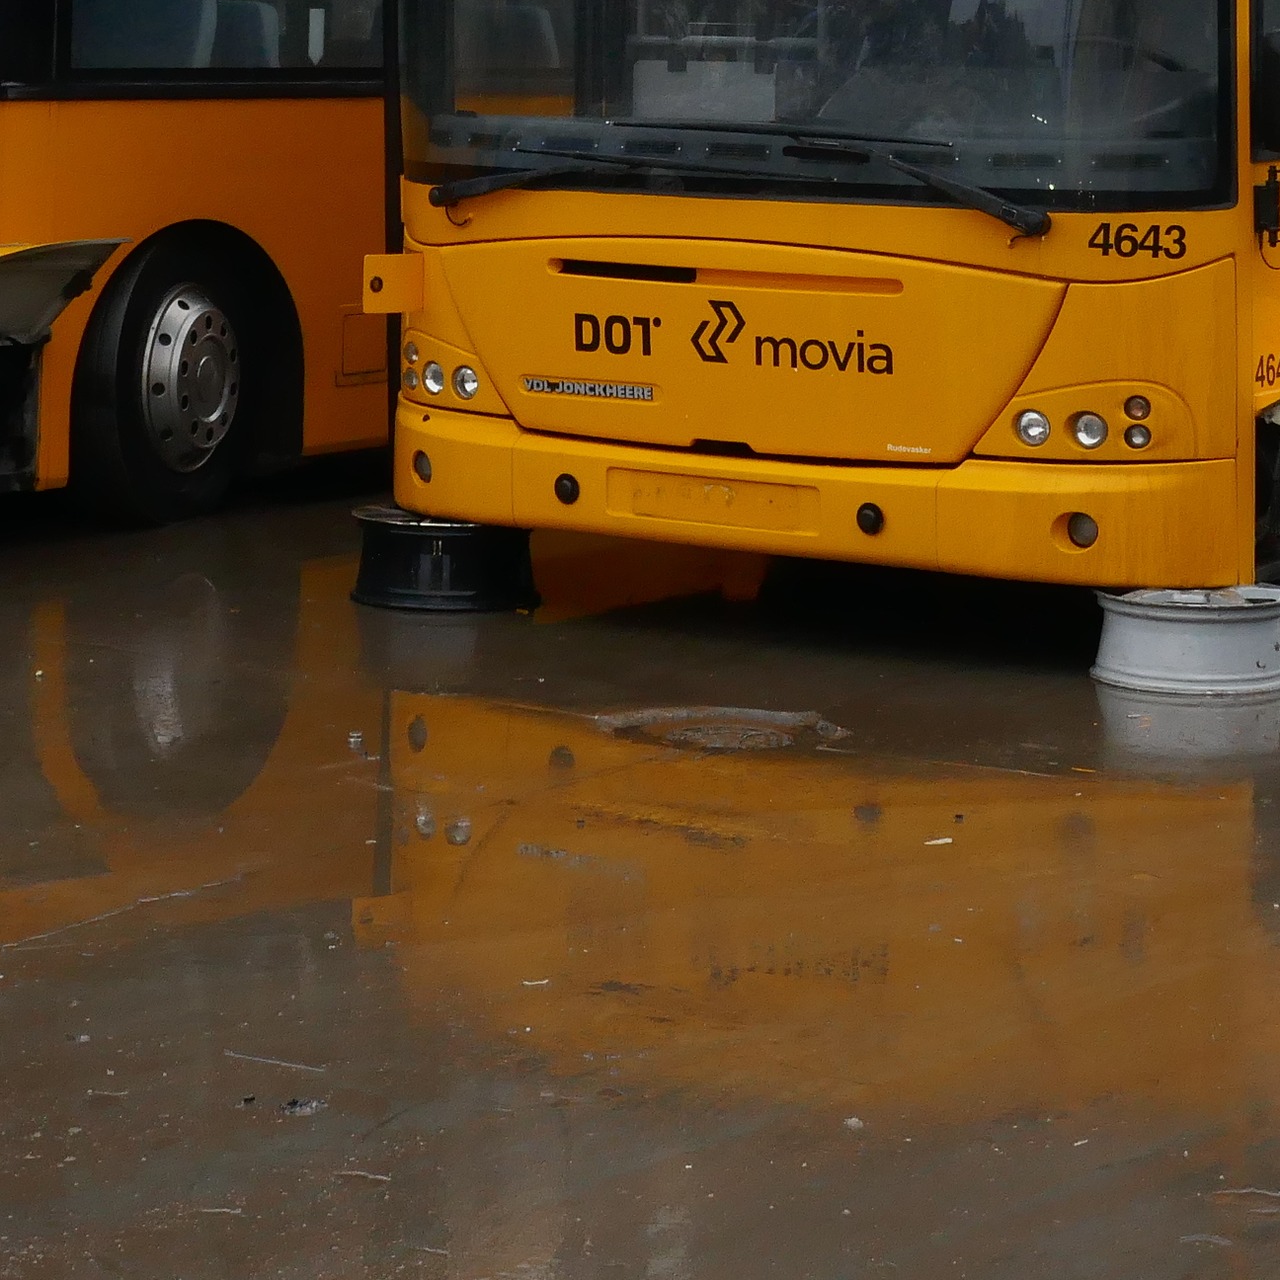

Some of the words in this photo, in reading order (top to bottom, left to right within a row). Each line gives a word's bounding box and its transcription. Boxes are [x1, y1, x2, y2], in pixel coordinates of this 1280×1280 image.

[1087, 222, 1187, 260] 4643
[574, 312, 661, 356] DOT
[754, 329, 894, 375] movia
[524, 377, 552, 393] VDL
[554, 380, 654, 400] JONCKHEERE
